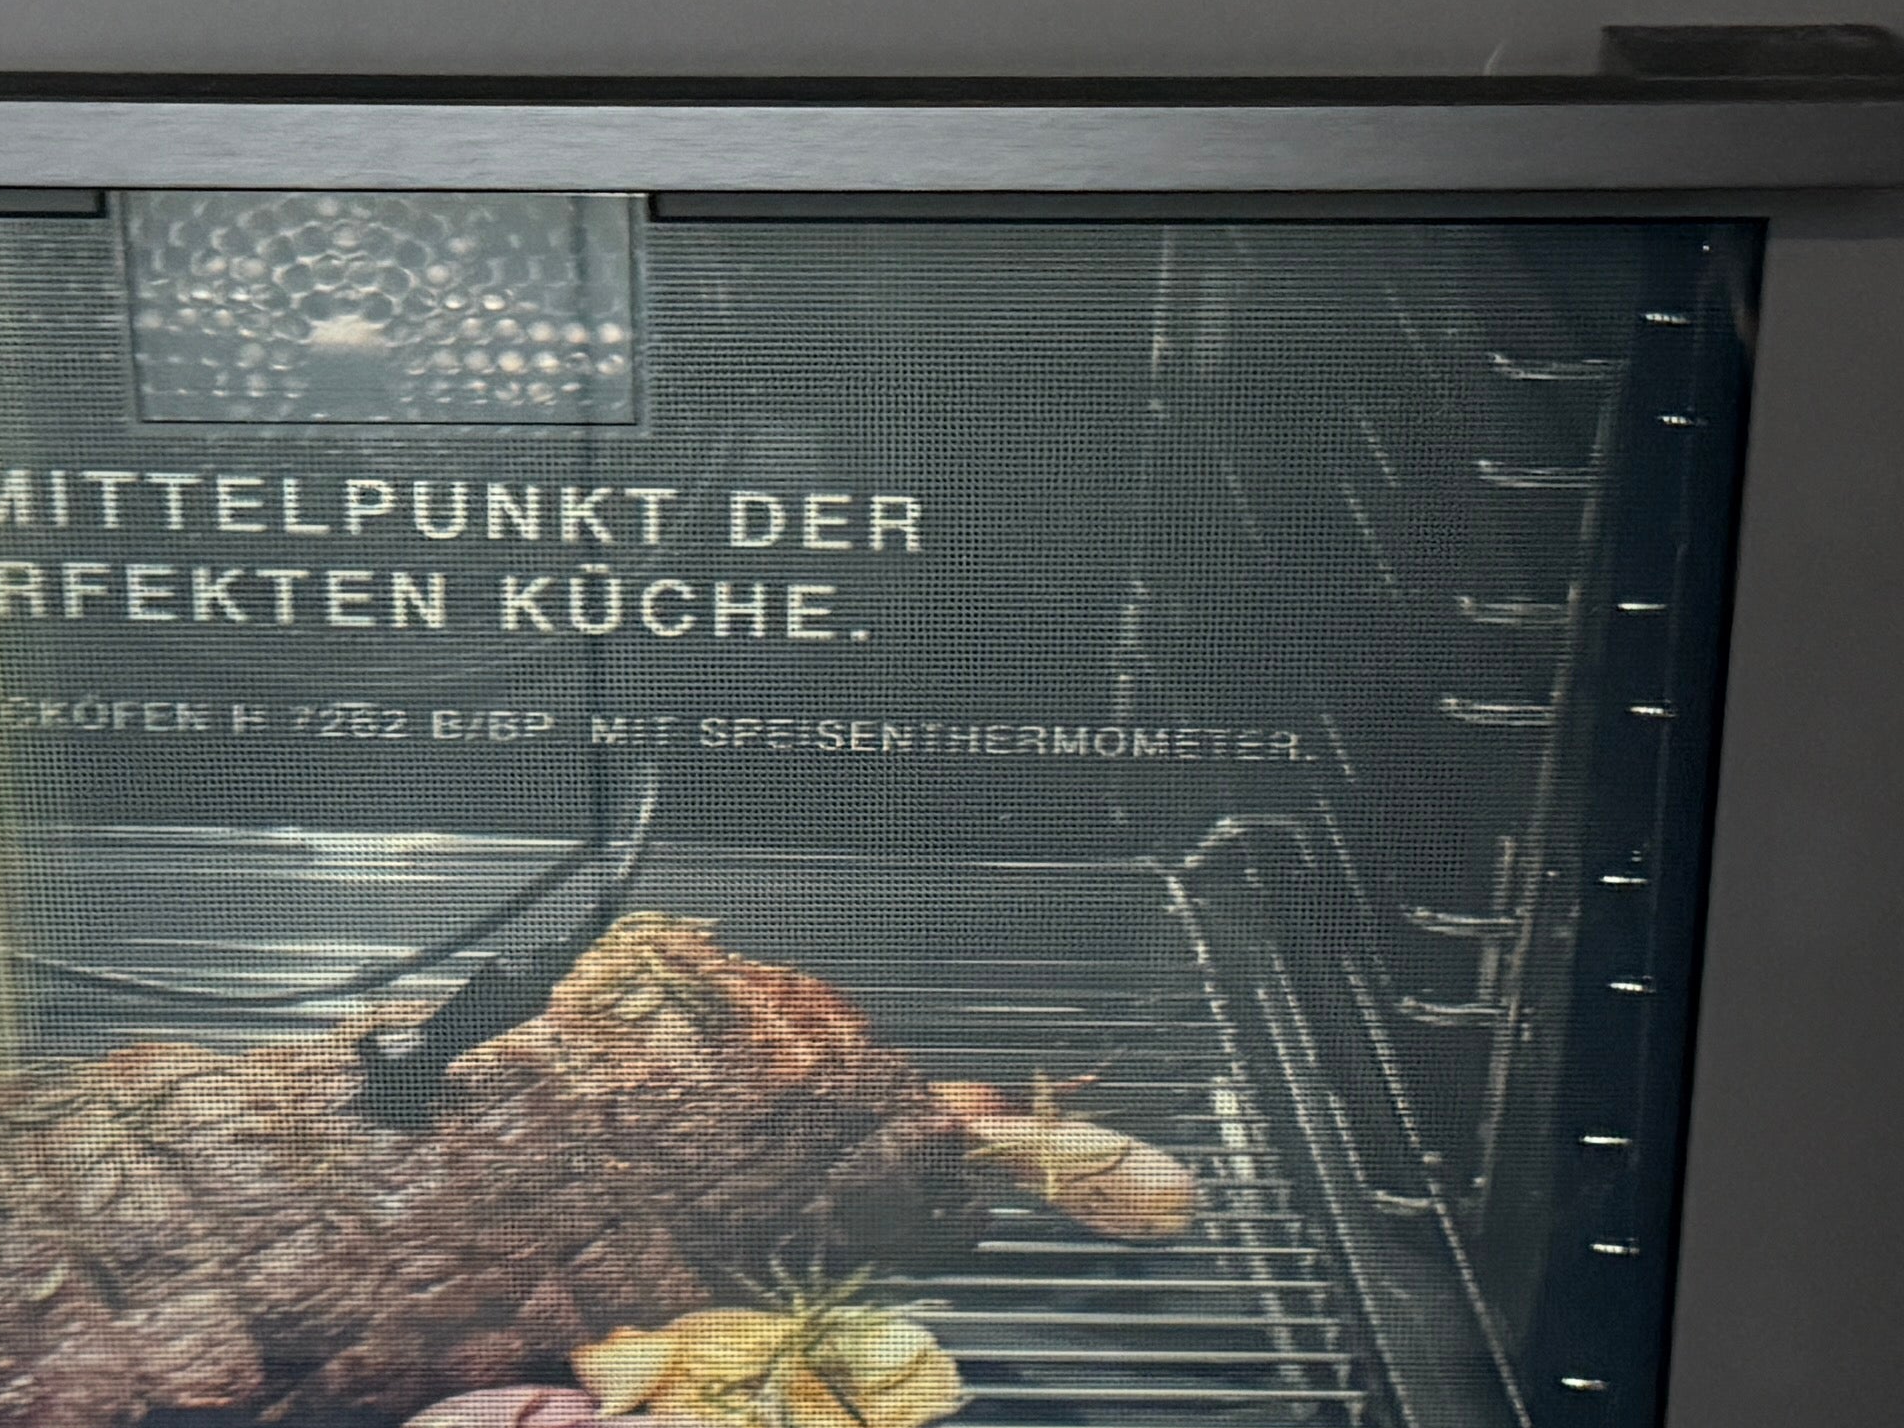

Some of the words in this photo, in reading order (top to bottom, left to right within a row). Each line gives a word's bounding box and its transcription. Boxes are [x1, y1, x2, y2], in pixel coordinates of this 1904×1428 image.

[729, 489, 924, 553] DER
[500, 563, 872, 642] KÜCHE.
[592, 715, 679, 746] MIT
[700, 717, 1317, 761] SPEISENTHERMOMETER.
